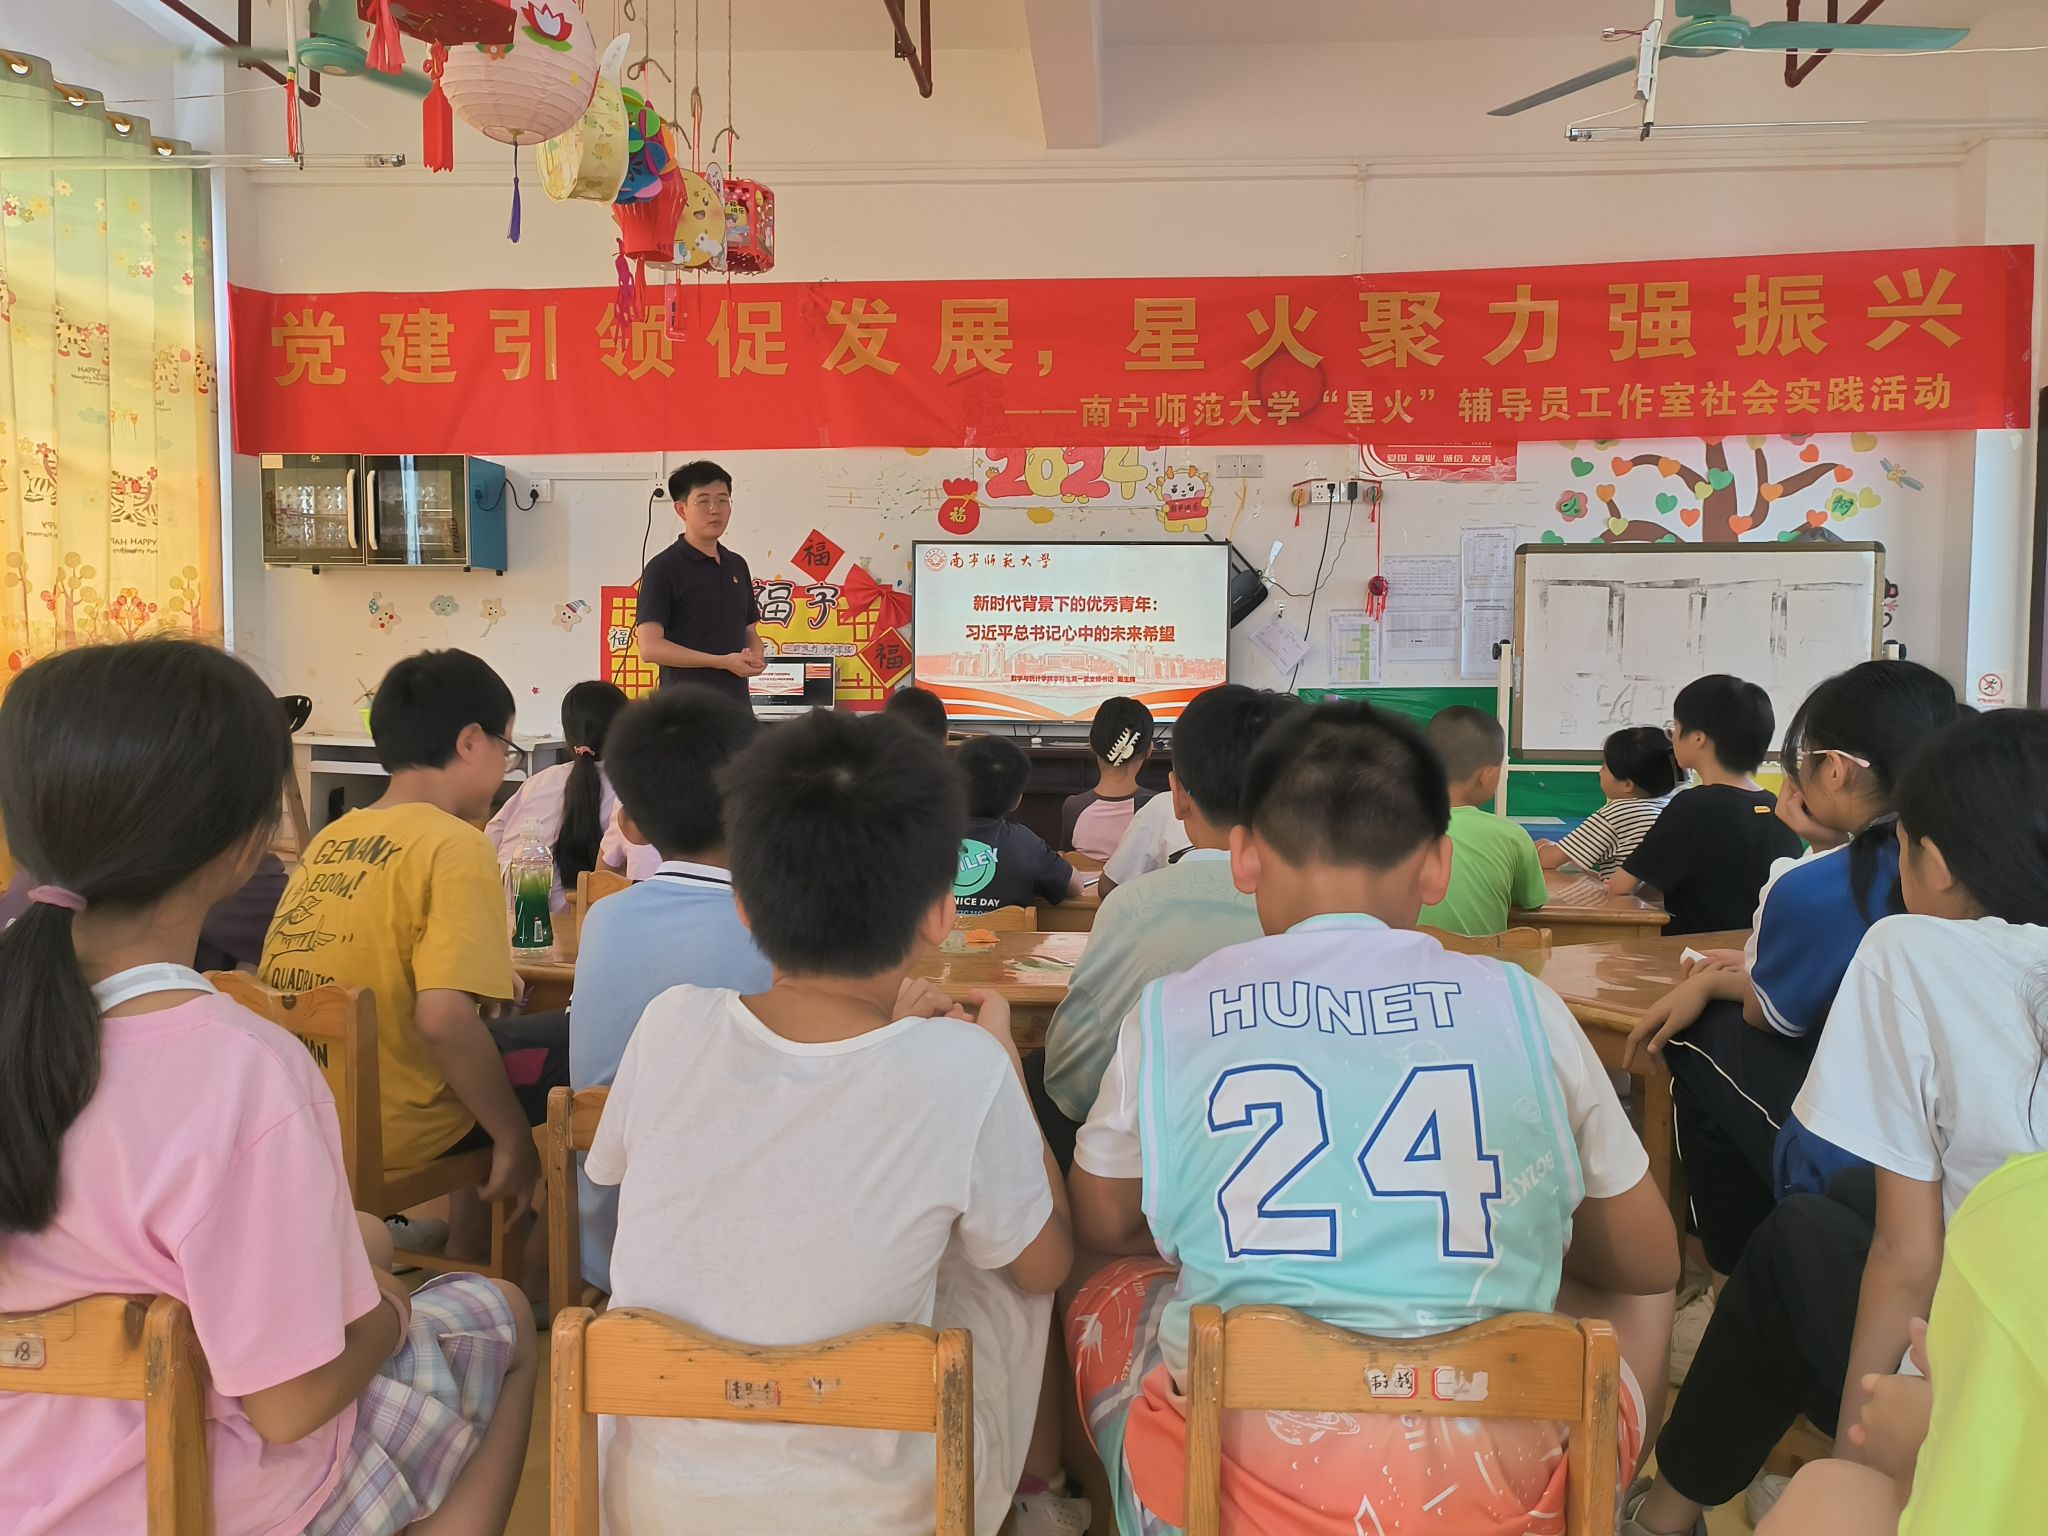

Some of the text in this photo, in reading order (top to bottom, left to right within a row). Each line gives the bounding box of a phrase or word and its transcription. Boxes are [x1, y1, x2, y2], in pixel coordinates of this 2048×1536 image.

[1387, 454, 1408, 463] 爱国
[1415, 454, 1436, 463] 敬业
[1471, 454, 1492, 463] 友善
[802, 539, 831, 567] 福
[609, 628, 629, 648] 福
[965, 625, 1176, 643] 习近平总书记心中的未来希望
[875, 643, 904, 669] 福
[957, 847, 999, 872] ILEY
[308, 870, 367, 900] BOOM!
[954, 897, 1000, 907] NICE DAY
[1209, 981, 1462, 1037] HUNET
[1206, 1062, 1503, 1261] 24
[15, 1341, 31, 1361] 18
